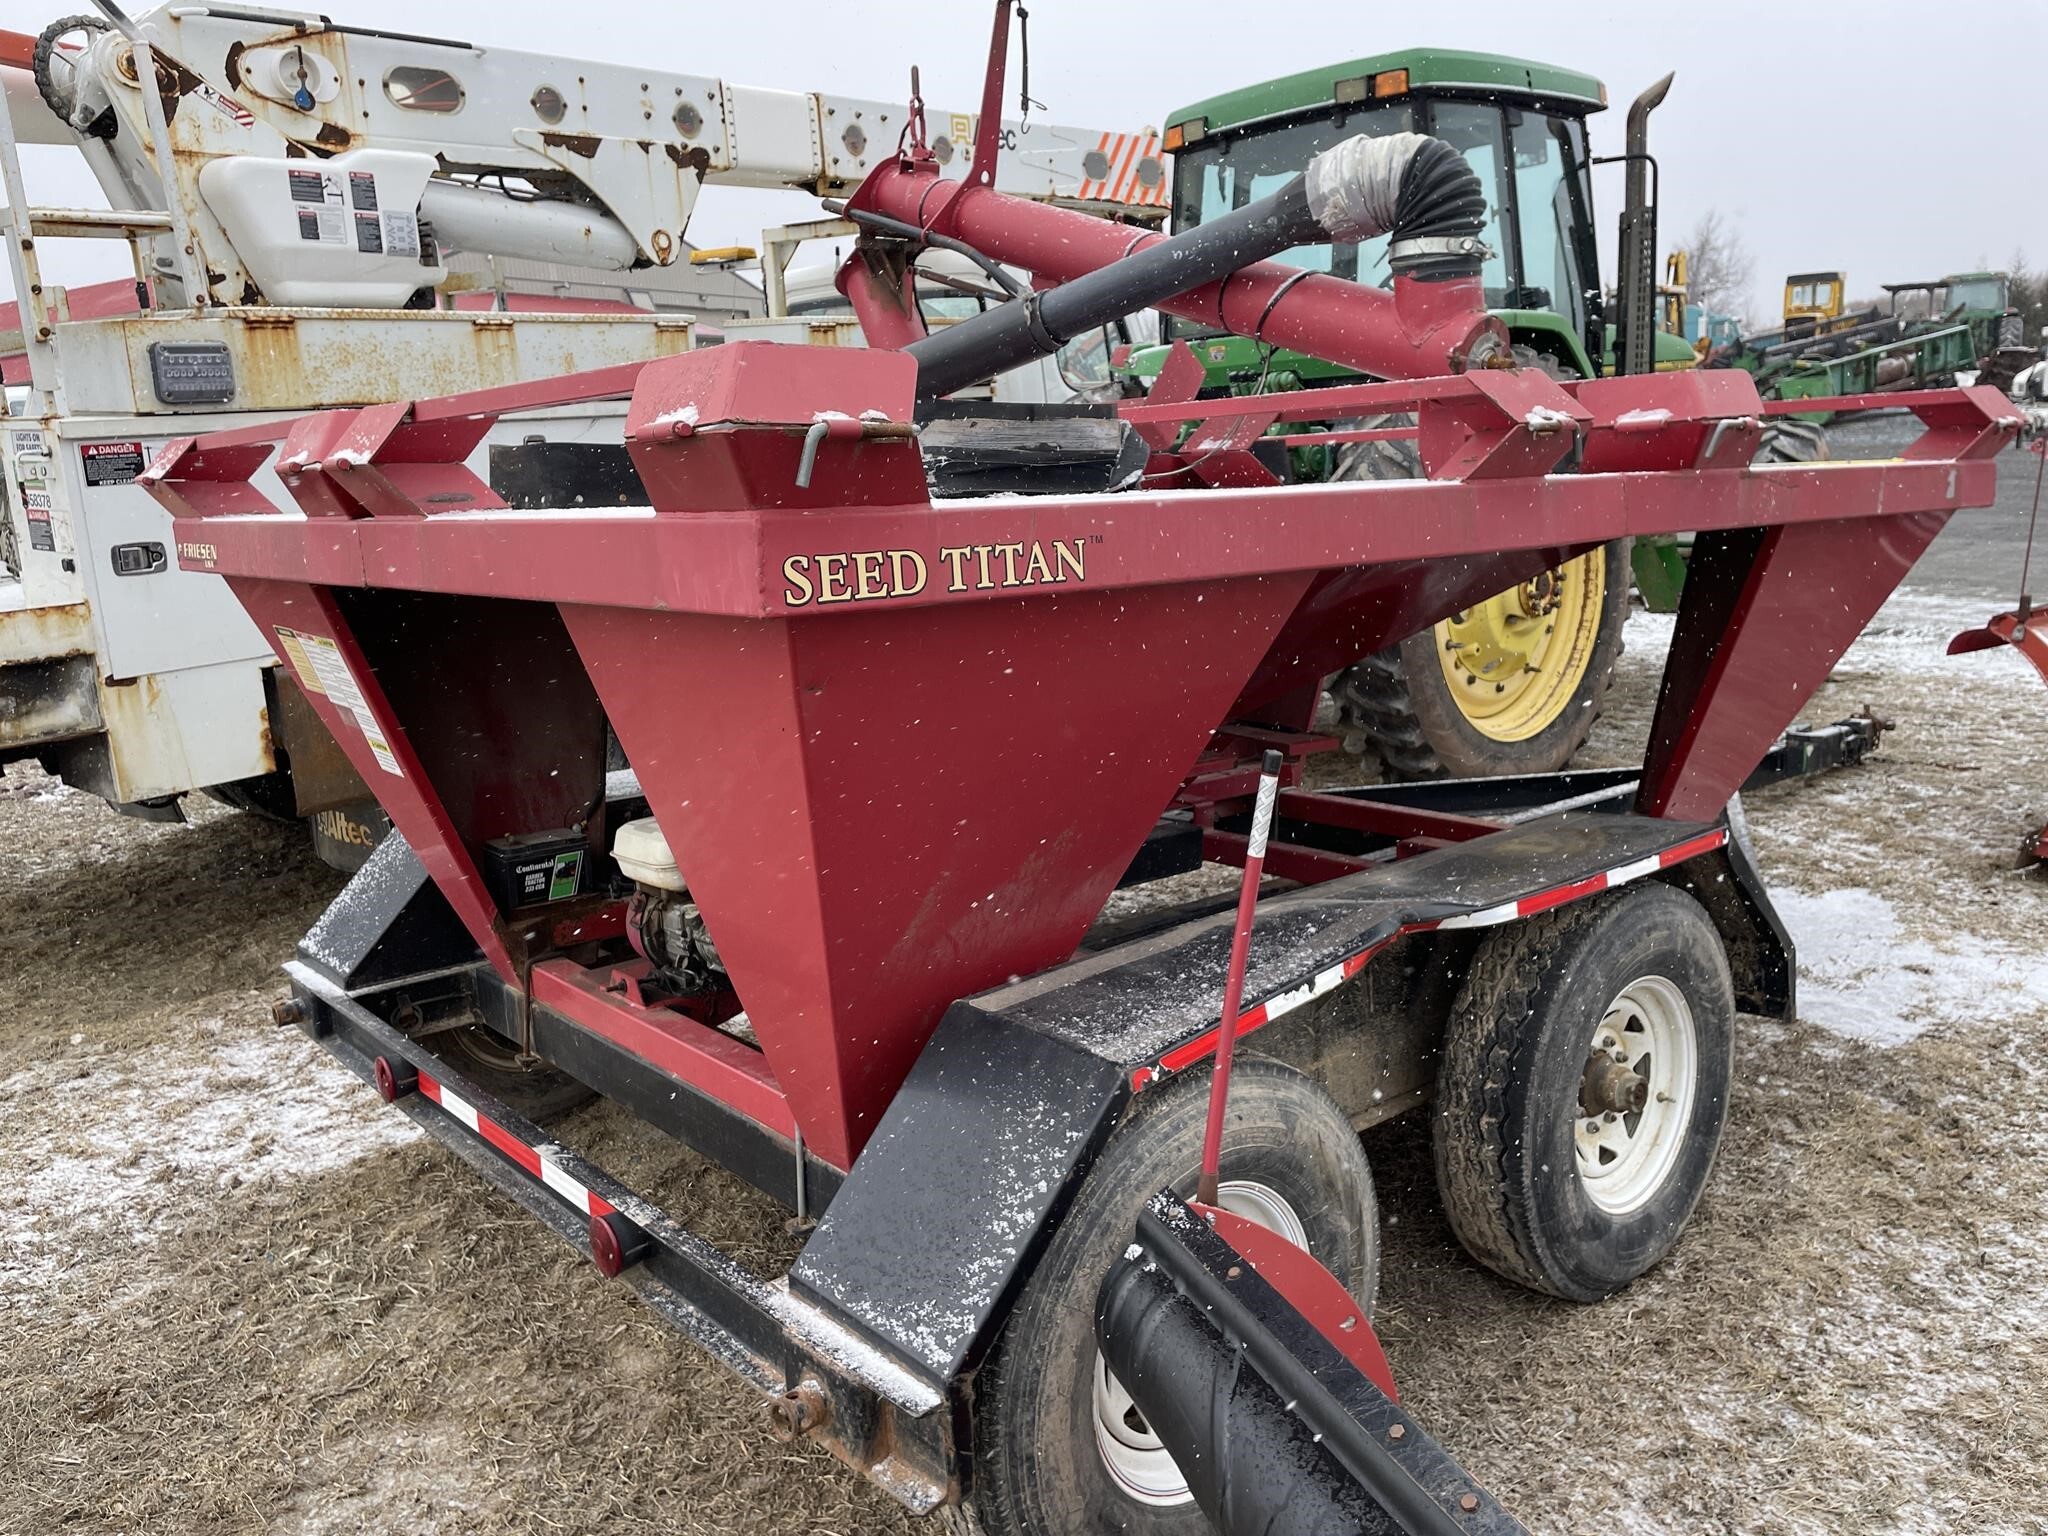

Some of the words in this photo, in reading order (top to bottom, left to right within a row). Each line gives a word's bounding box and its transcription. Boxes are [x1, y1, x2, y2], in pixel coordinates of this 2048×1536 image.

[98, 444, 135, 454] DANGER
[183, 543, 217, 560] FRIESEN
[782, 549, 928, 608] SEED
[939, 538, 1086, 592] TITAN
[327, 809, 374, 847] Altec
[515, 859, 554, 874] Continental
